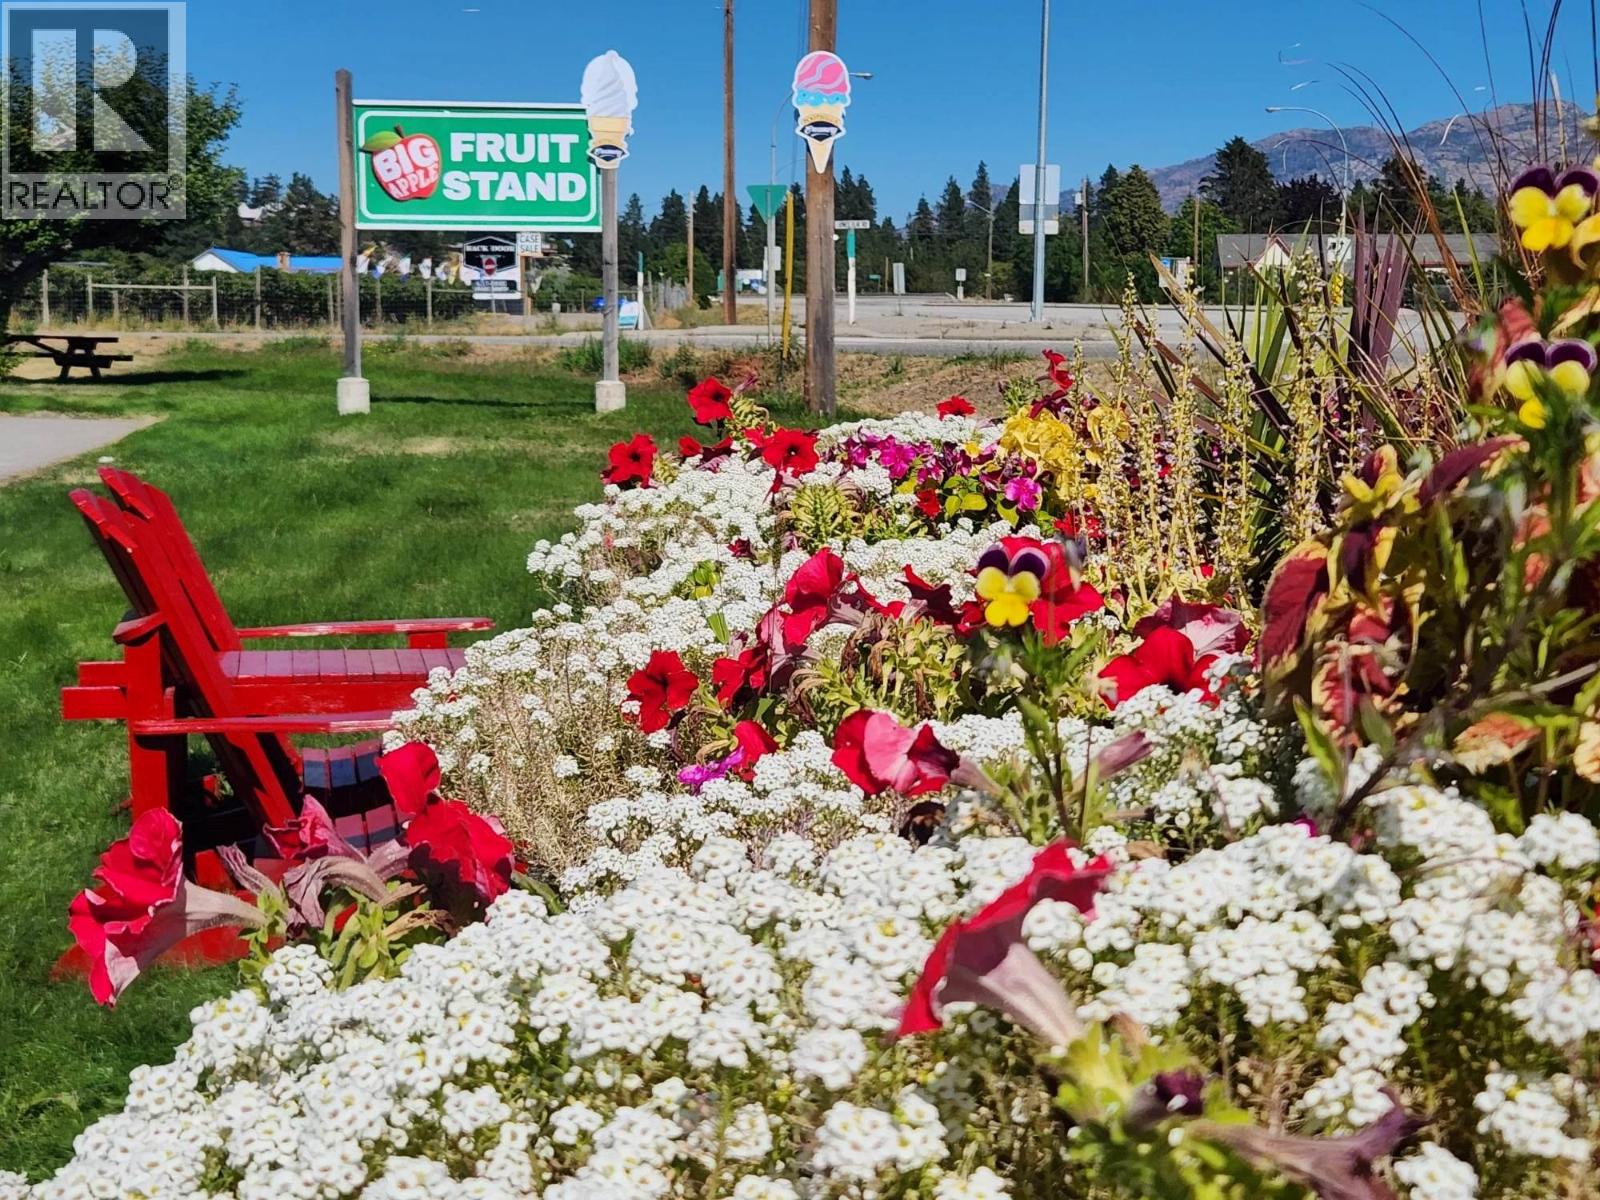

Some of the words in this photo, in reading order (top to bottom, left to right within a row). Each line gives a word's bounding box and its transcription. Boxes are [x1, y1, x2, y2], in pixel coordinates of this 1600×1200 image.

[373, 137, 436, 183] BIG
[451, 133, 580, 163] FRUIT
[387, 163, 440, 200] APPLE
[444, 171, 588, 202] STAND
[519, 234, 539, 243] CASE
[520, 244, 539, 253] SALE
